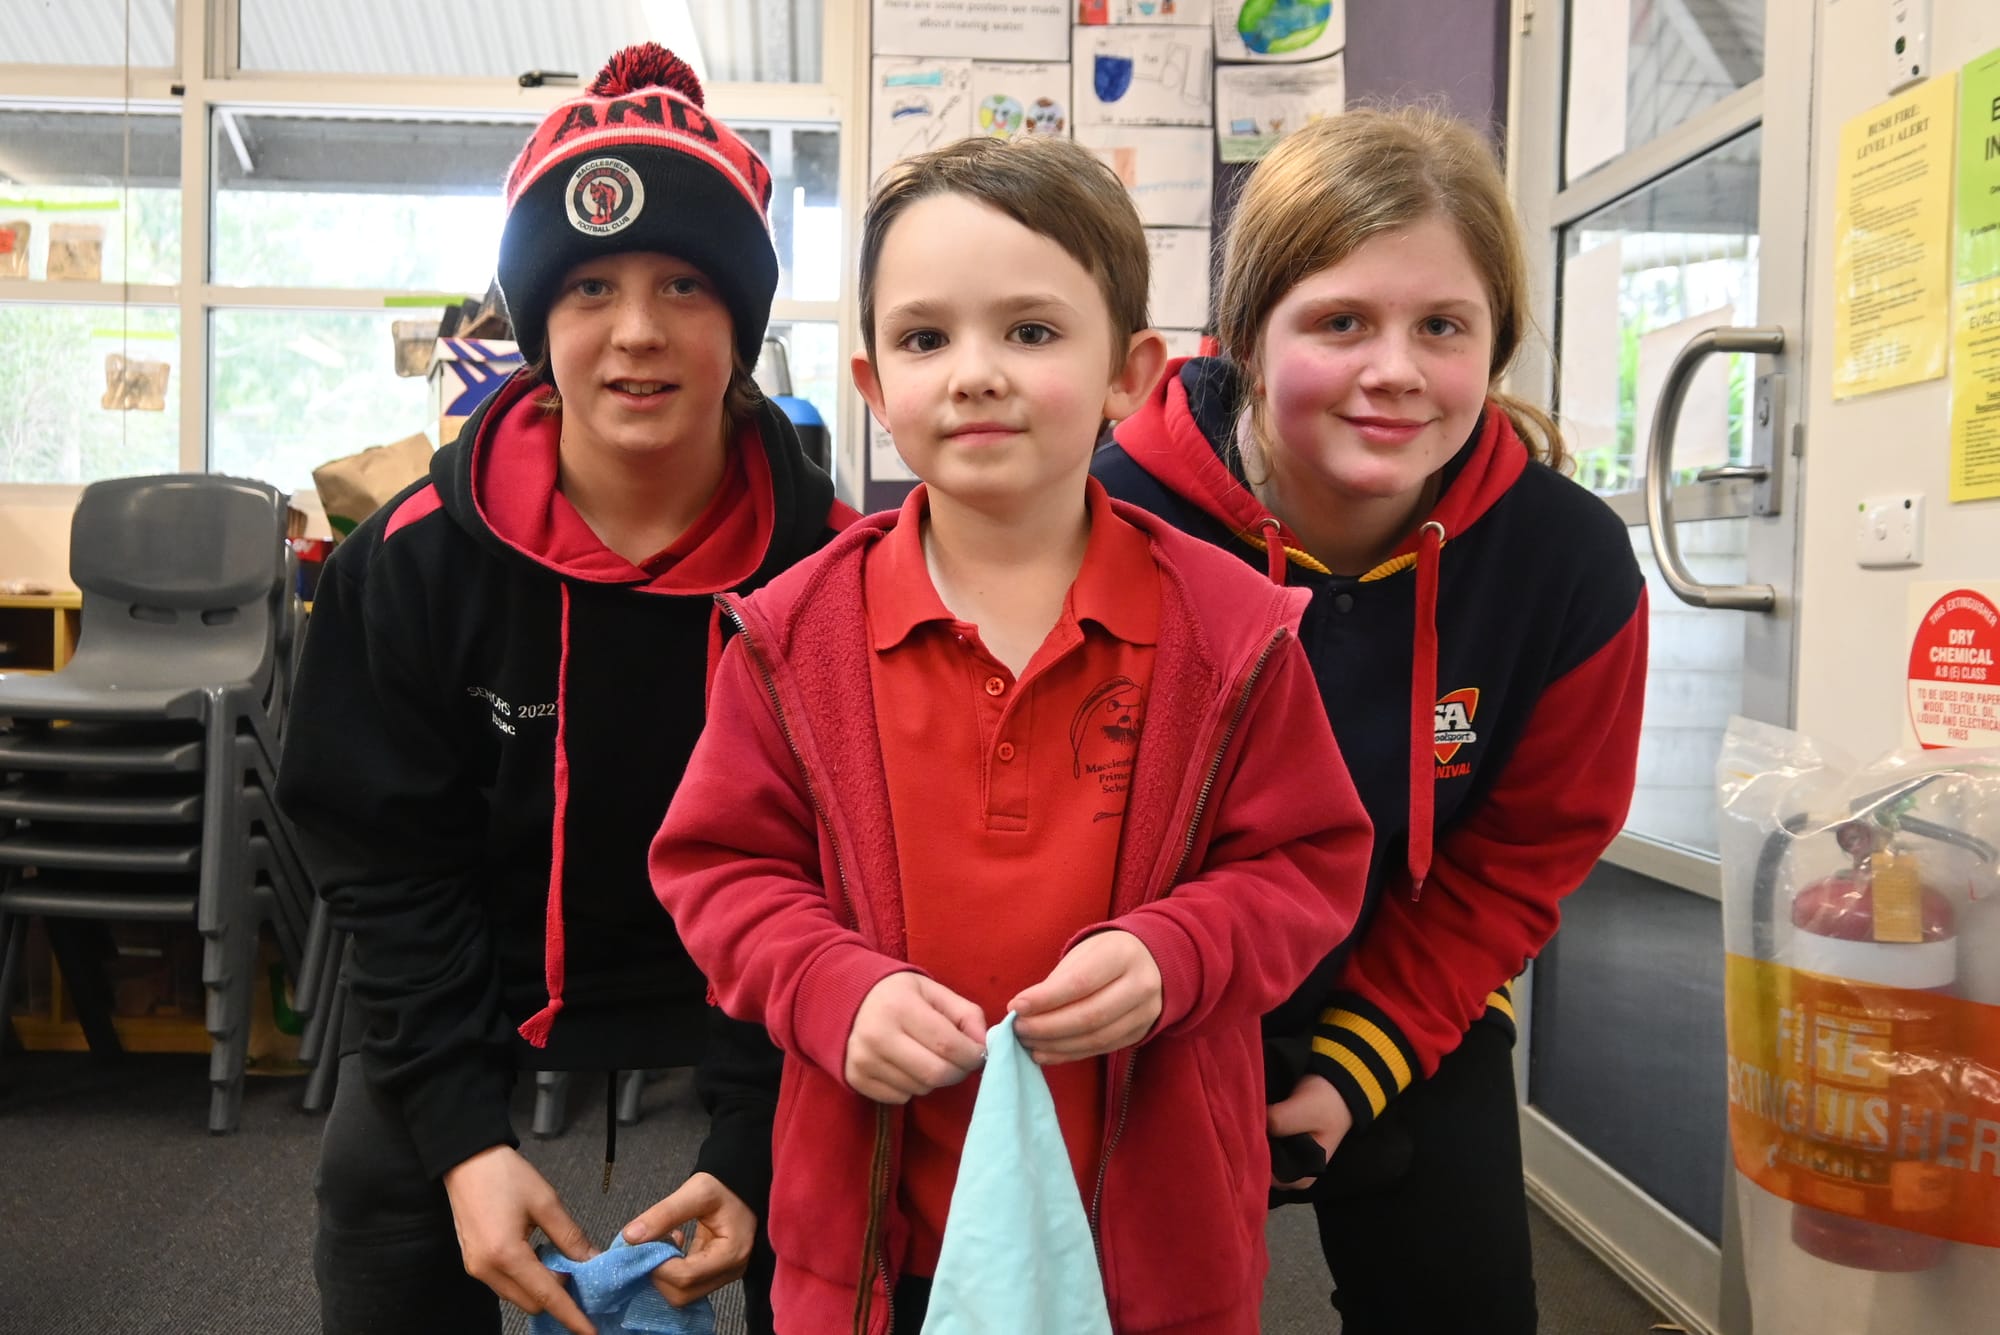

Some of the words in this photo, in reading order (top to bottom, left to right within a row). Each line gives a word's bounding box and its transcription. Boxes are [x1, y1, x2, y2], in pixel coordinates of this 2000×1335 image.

[919, 16, 951, 28] about
[551, 95, 719, 143] AND
[1867, 116, 1893, 138] BUSH
[1857, 138, 1886, 160] LEVEL
[1897, 118, 1929, 141] ALERT
[575, 159, 630, 180] MACCLESFIELD
[577, 220, 611, 233] FOOTBALL
[611, 215, 630, 230] CLUB
[1928, 603, 1947, 625] THIS
[1945, 596, 1998, 628] EXTINGUISHER
[1948, 628, 1976, 646] DRY
[1929, 646, 1994, 666] CHEMICAL
[1961, 666, 1987, 681] CLASS
[1918, 687, 1927, 700] TO
[1928, 688, 1938, 700] BE
[1940, 690, 1958, 702] USED
[1960, 691, 1975, 703] FOR
[517, 702, 557, 719] 2022
[1917, 712, 1940, 725] LIQUID
[1943, 715, 1957, 727] AND
[1948, 728, 1969, 741] FIRES
